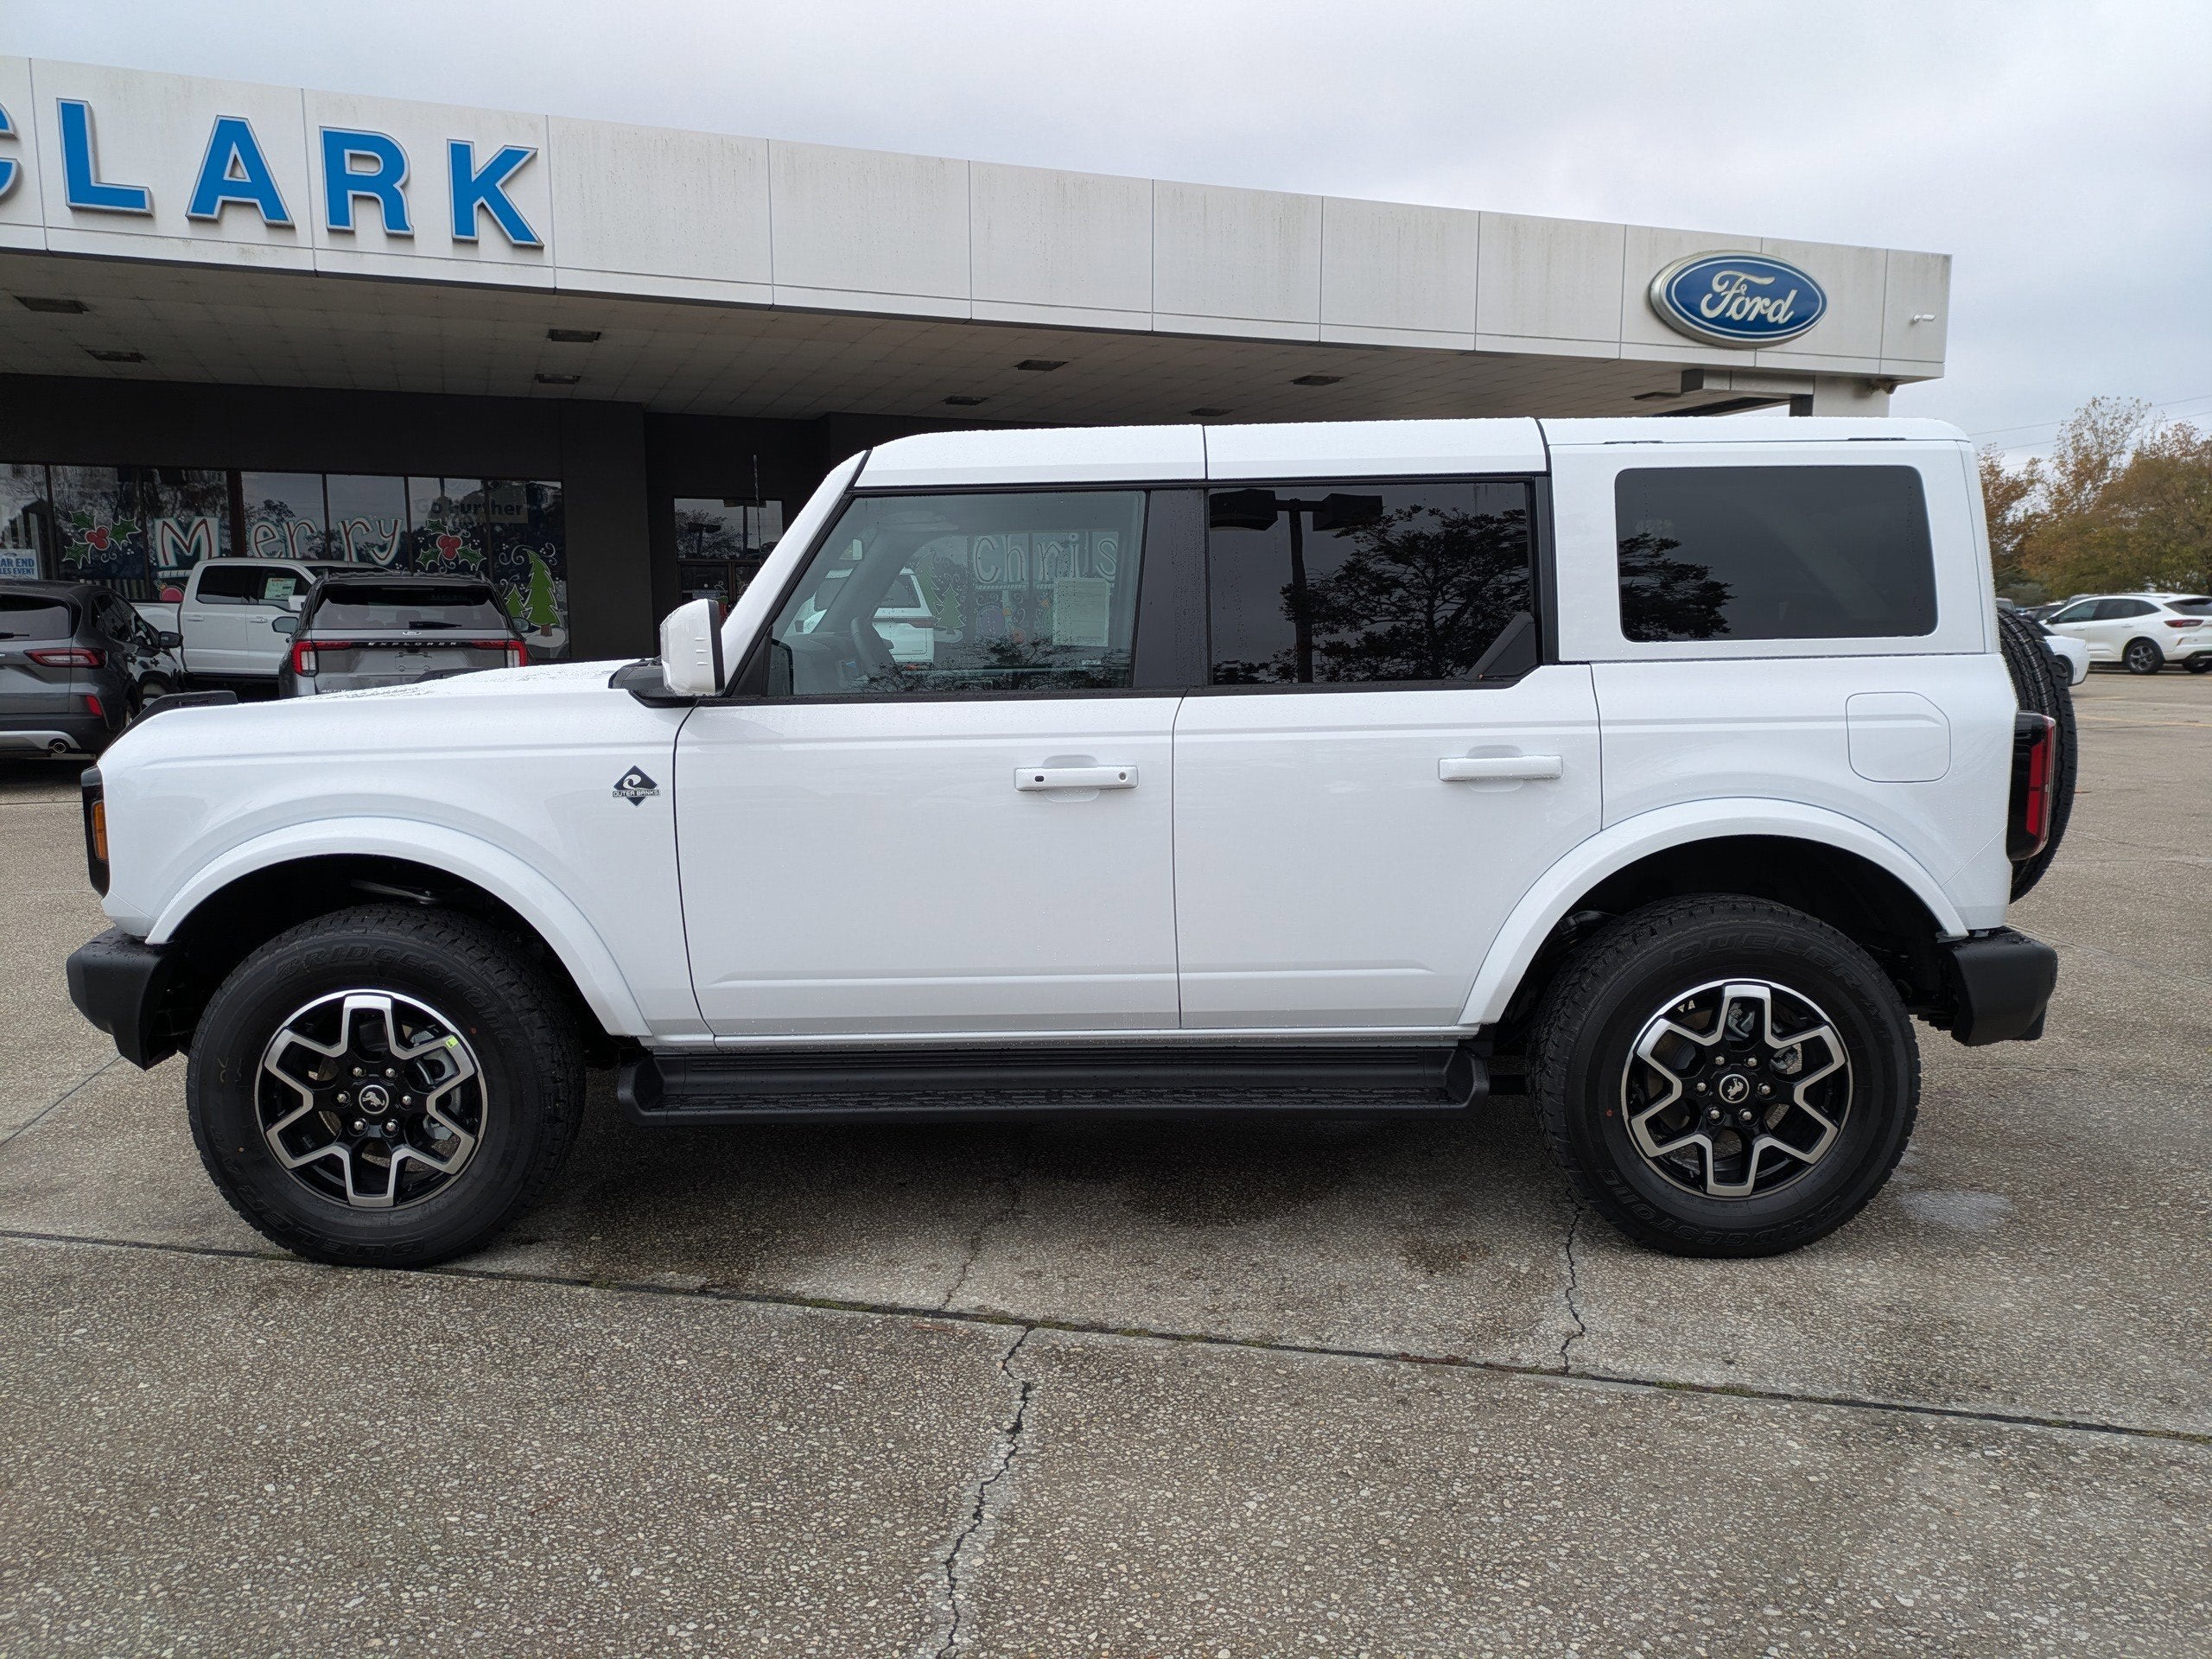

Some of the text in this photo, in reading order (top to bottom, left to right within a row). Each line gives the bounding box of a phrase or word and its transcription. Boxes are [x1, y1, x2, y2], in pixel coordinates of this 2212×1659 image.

[0, 97, 545, 249] LARK
[1700, 270, 1798, 325] Ford
[16, 557, 35, 568] END
[154, 516, 404, 569] Merry
[972, 531, 1118, 584] Chris
[1669, 933, 1863, 988] DUELER
[276, 943, 516, 1051] BRIDGESTONE
[238, 1185, 425, 1259] DUELER
[1597, 1168, 1840, 1248] BRIDGESTONE
